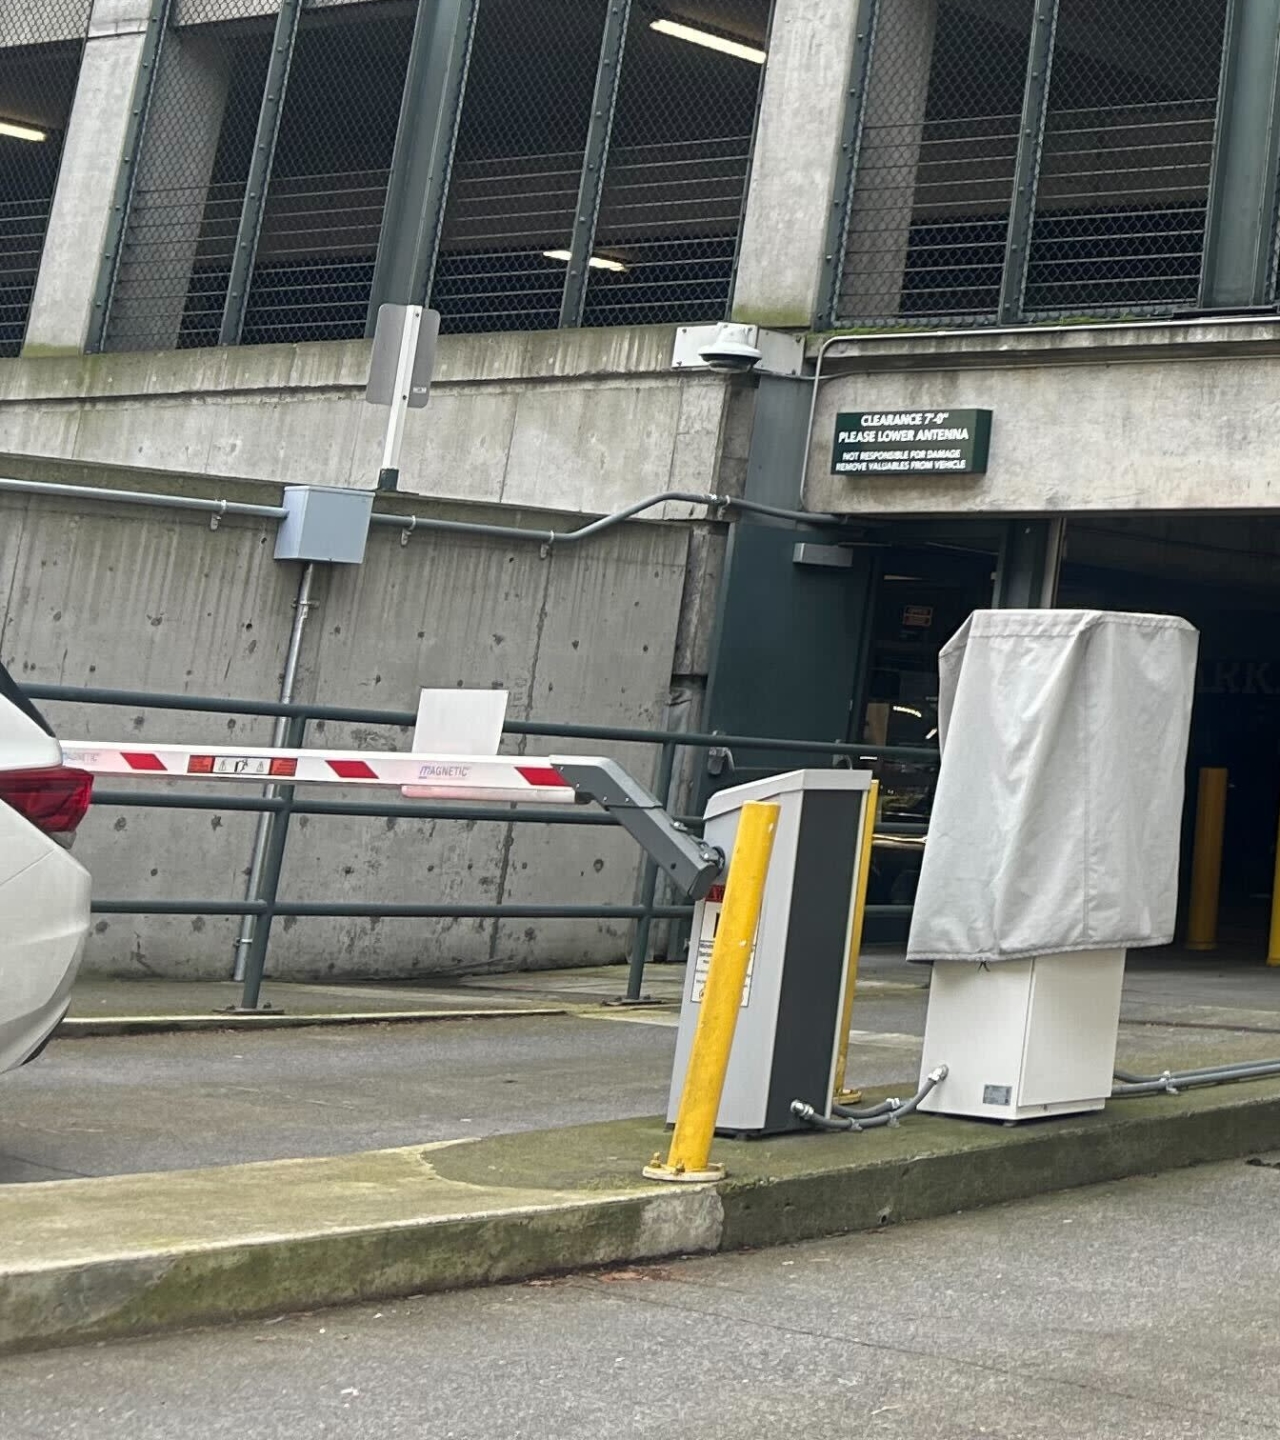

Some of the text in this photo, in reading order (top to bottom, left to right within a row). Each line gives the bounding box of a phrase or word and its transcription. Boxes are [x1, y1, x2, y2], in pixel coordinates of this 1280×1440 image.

[860, 413, 923, 427] CLEARANCE
[838, 428, 970, 444] PLEASE LOWER ANTENNA
[842, 449, 961, 461] NOT RESPONSIBLE FOR DAMAGE
[835, 460, 966, 472] REMOVE VALUABLES FROM VEHICLE
